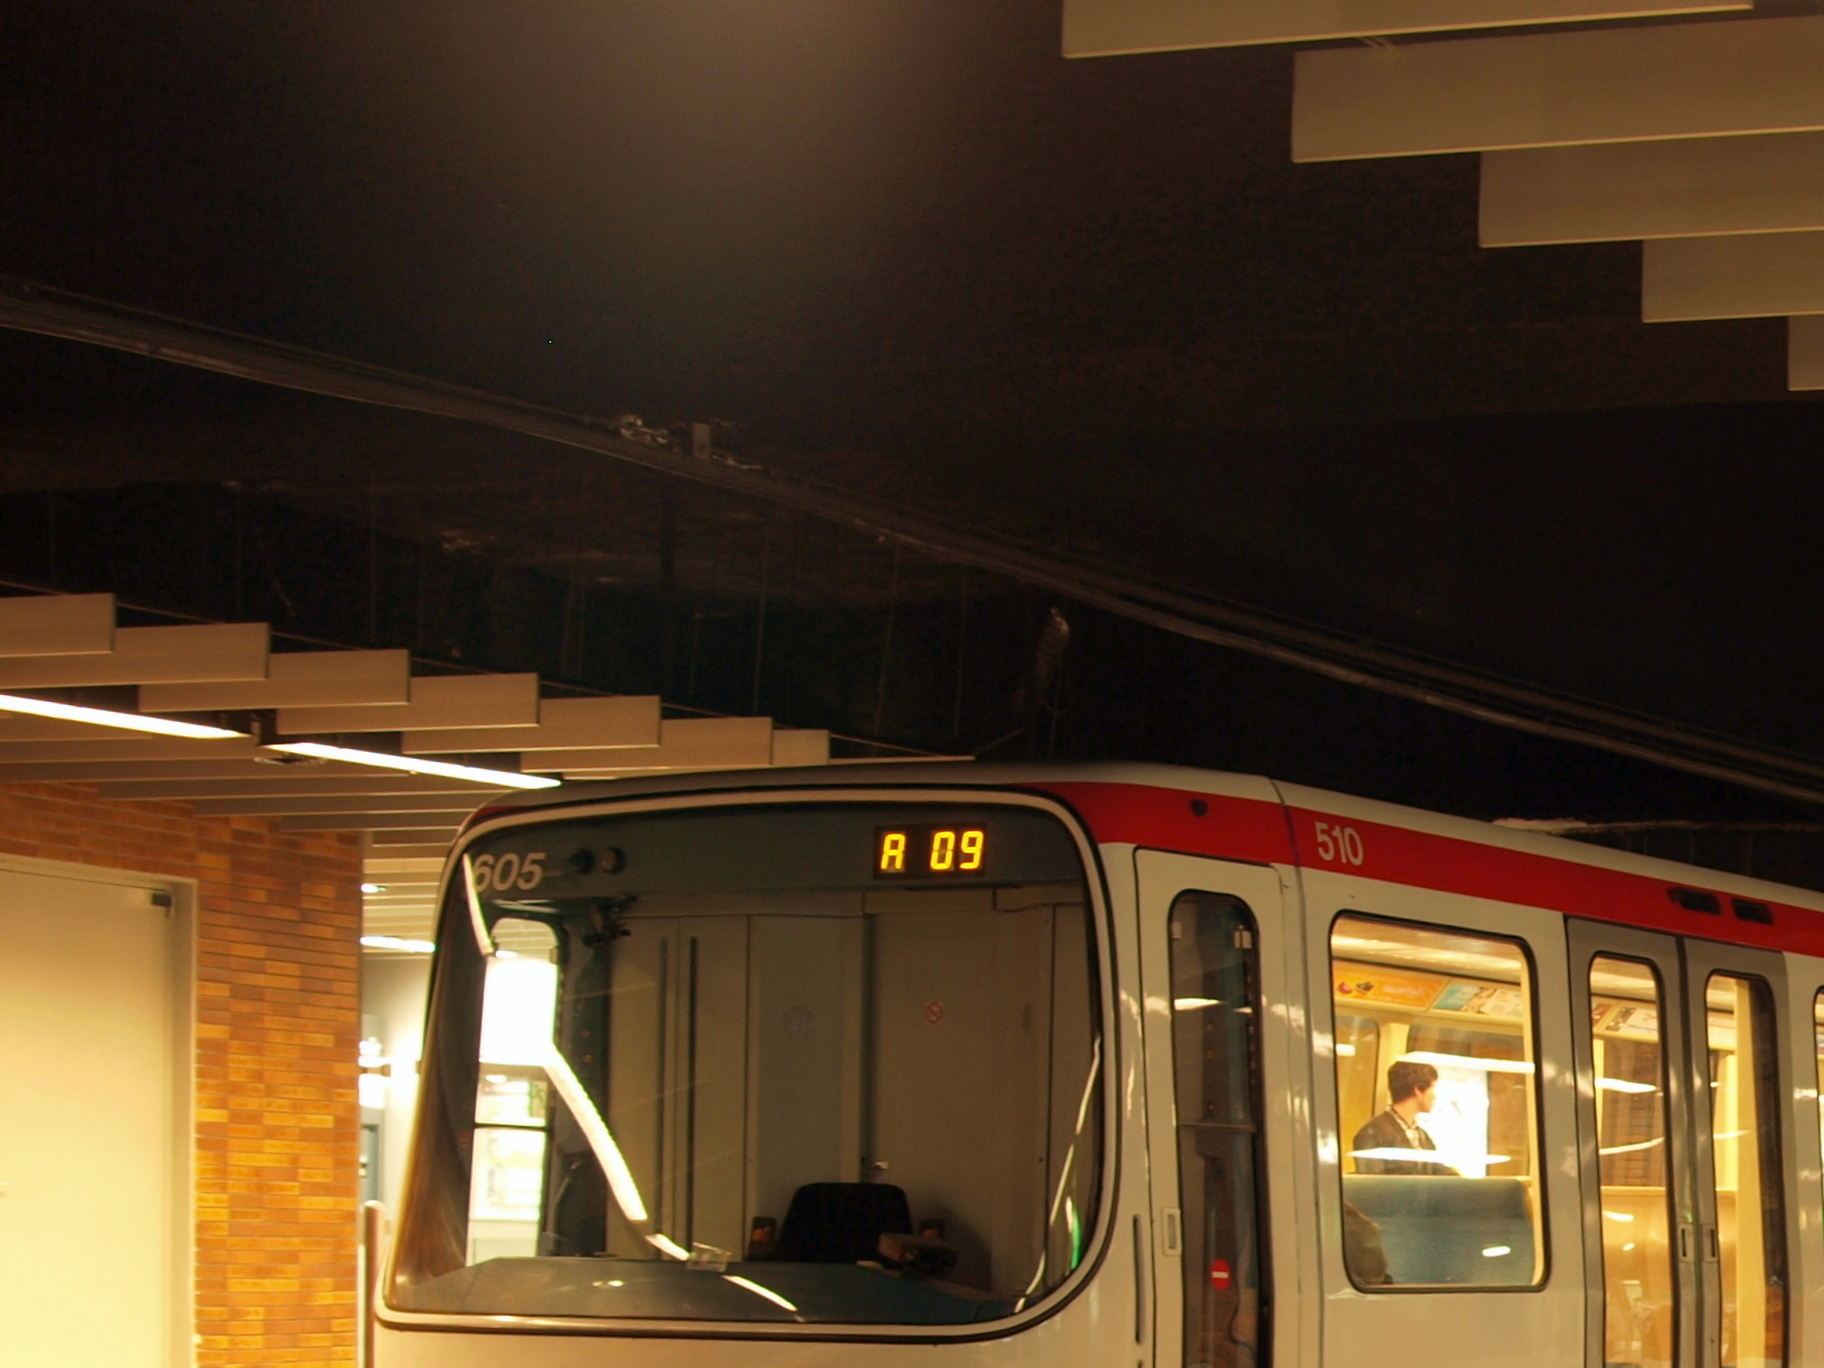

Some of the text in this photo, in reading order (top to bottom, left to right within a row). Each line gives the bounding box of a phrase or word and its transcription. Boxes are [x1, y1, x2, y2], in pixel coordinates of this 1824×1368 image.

[880, 831, 984, 870] A 09
[1315, 821, 1363, 866] 510
[473, 852, 547, 892] 605
